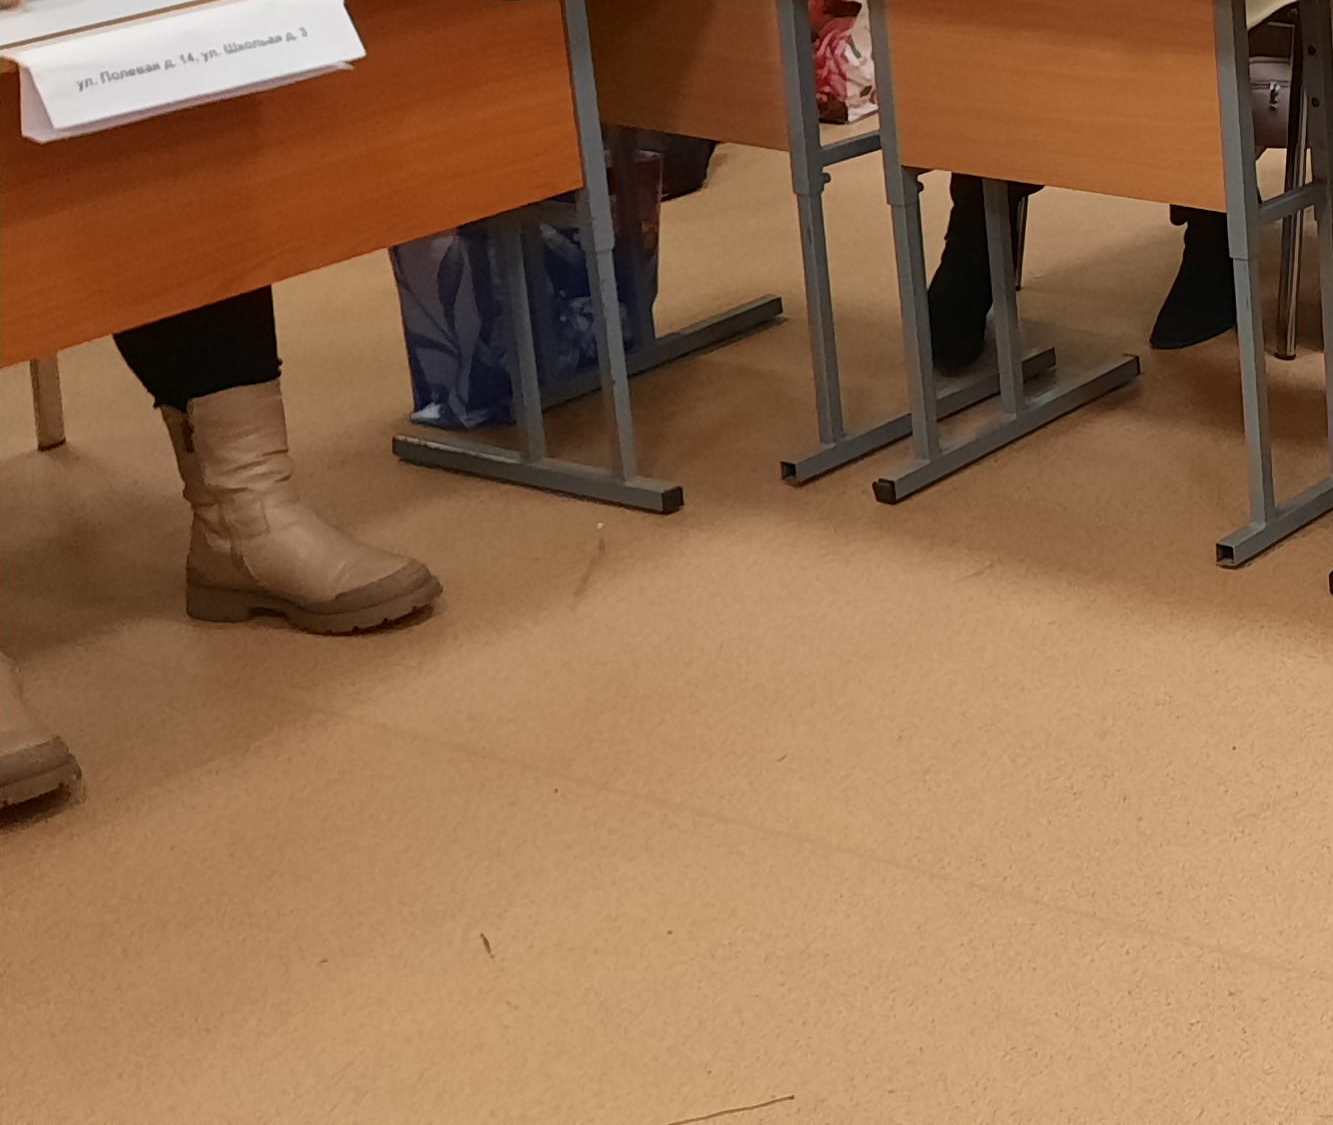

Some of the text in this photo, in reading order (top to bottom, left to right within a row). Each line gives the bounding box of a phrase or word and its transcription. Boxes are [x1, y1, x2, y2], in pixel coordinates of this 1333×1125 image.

[76, 78, 98, 91] ул.
[100, 62, 161, 83] Полевая
[200, 47, 220, 59] ул.
[223, 34, 284, 55] Школьная
